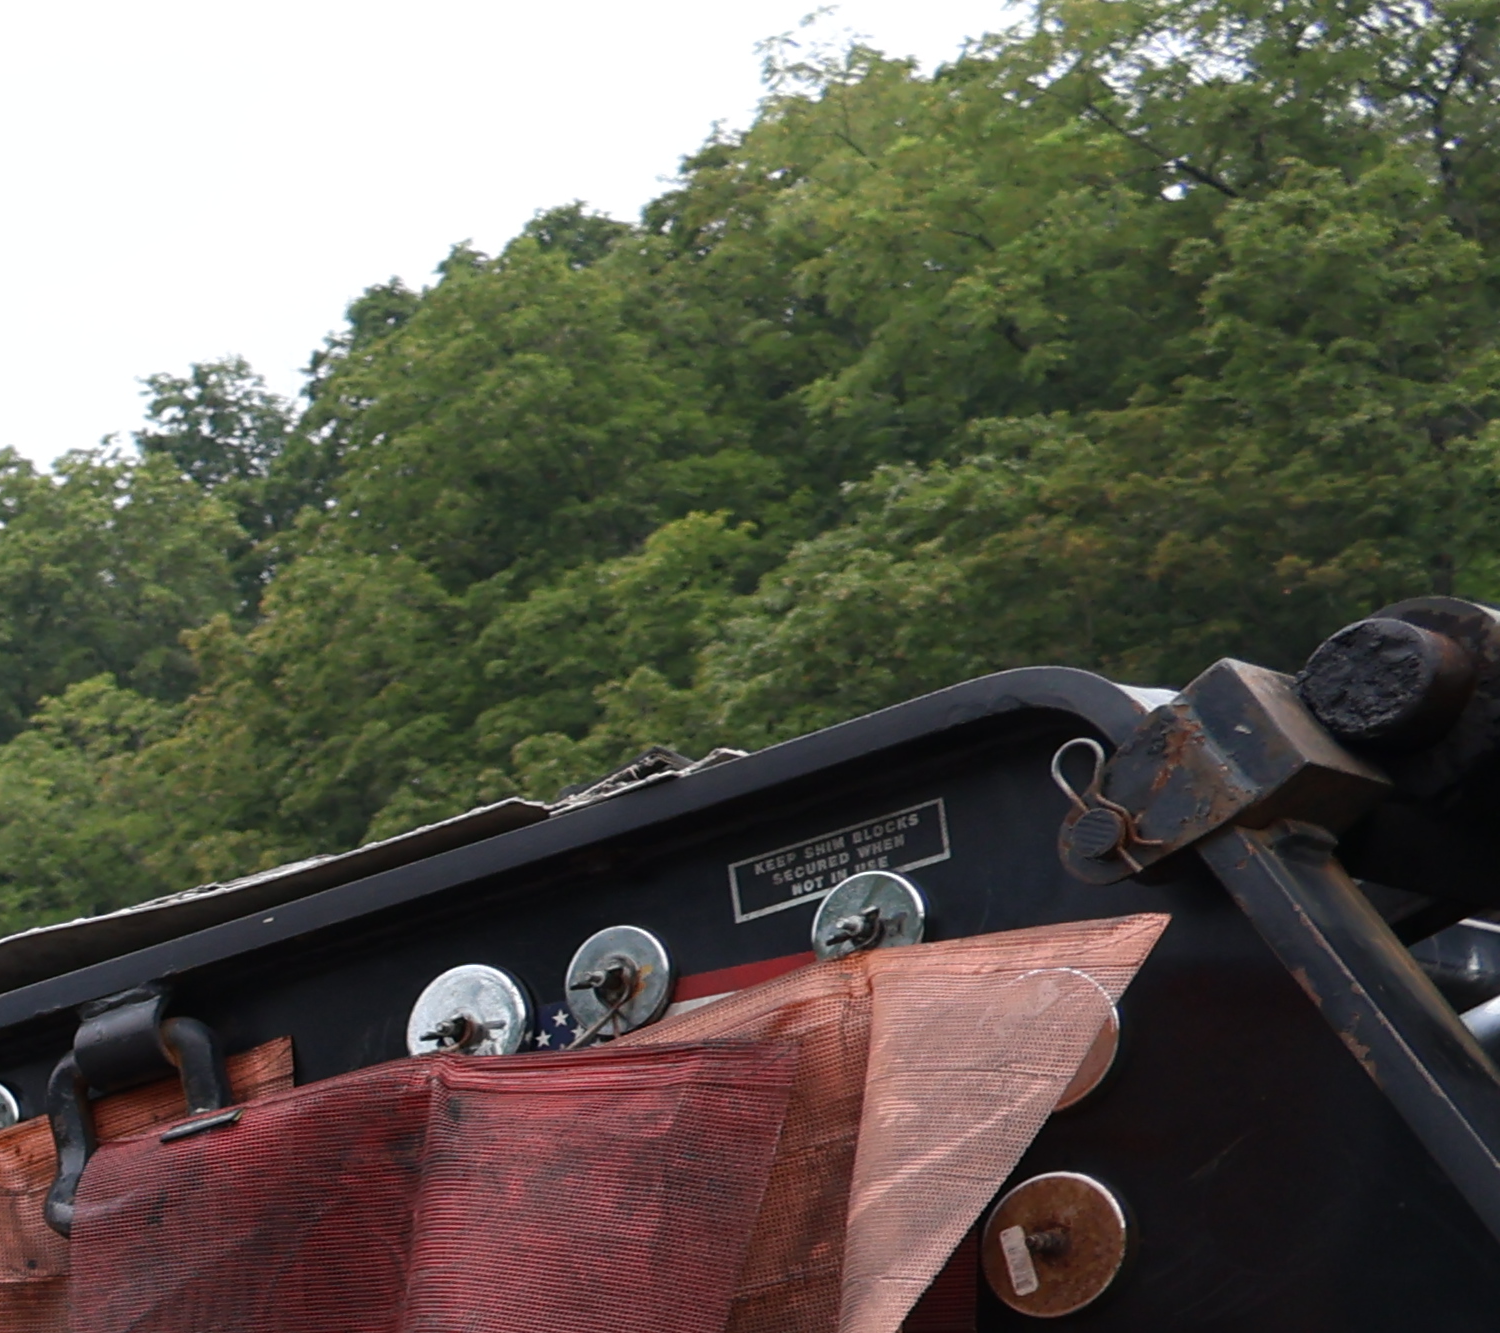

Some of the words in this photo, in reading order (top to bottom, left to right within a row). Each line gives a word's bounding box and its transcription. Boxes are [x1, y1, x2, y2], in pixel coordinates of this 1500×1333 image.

[754, 855, 797, 875] KEEP
[804, 837, 846, 859] SHIM
[852, 812, 920, 844] BLOCKS
[772, 852, 851, 886] SECURED
[856, 834, 906, 861] WHEN
[791, 877, 825, 897] NOT
[830, 868, 849, 885] IN
